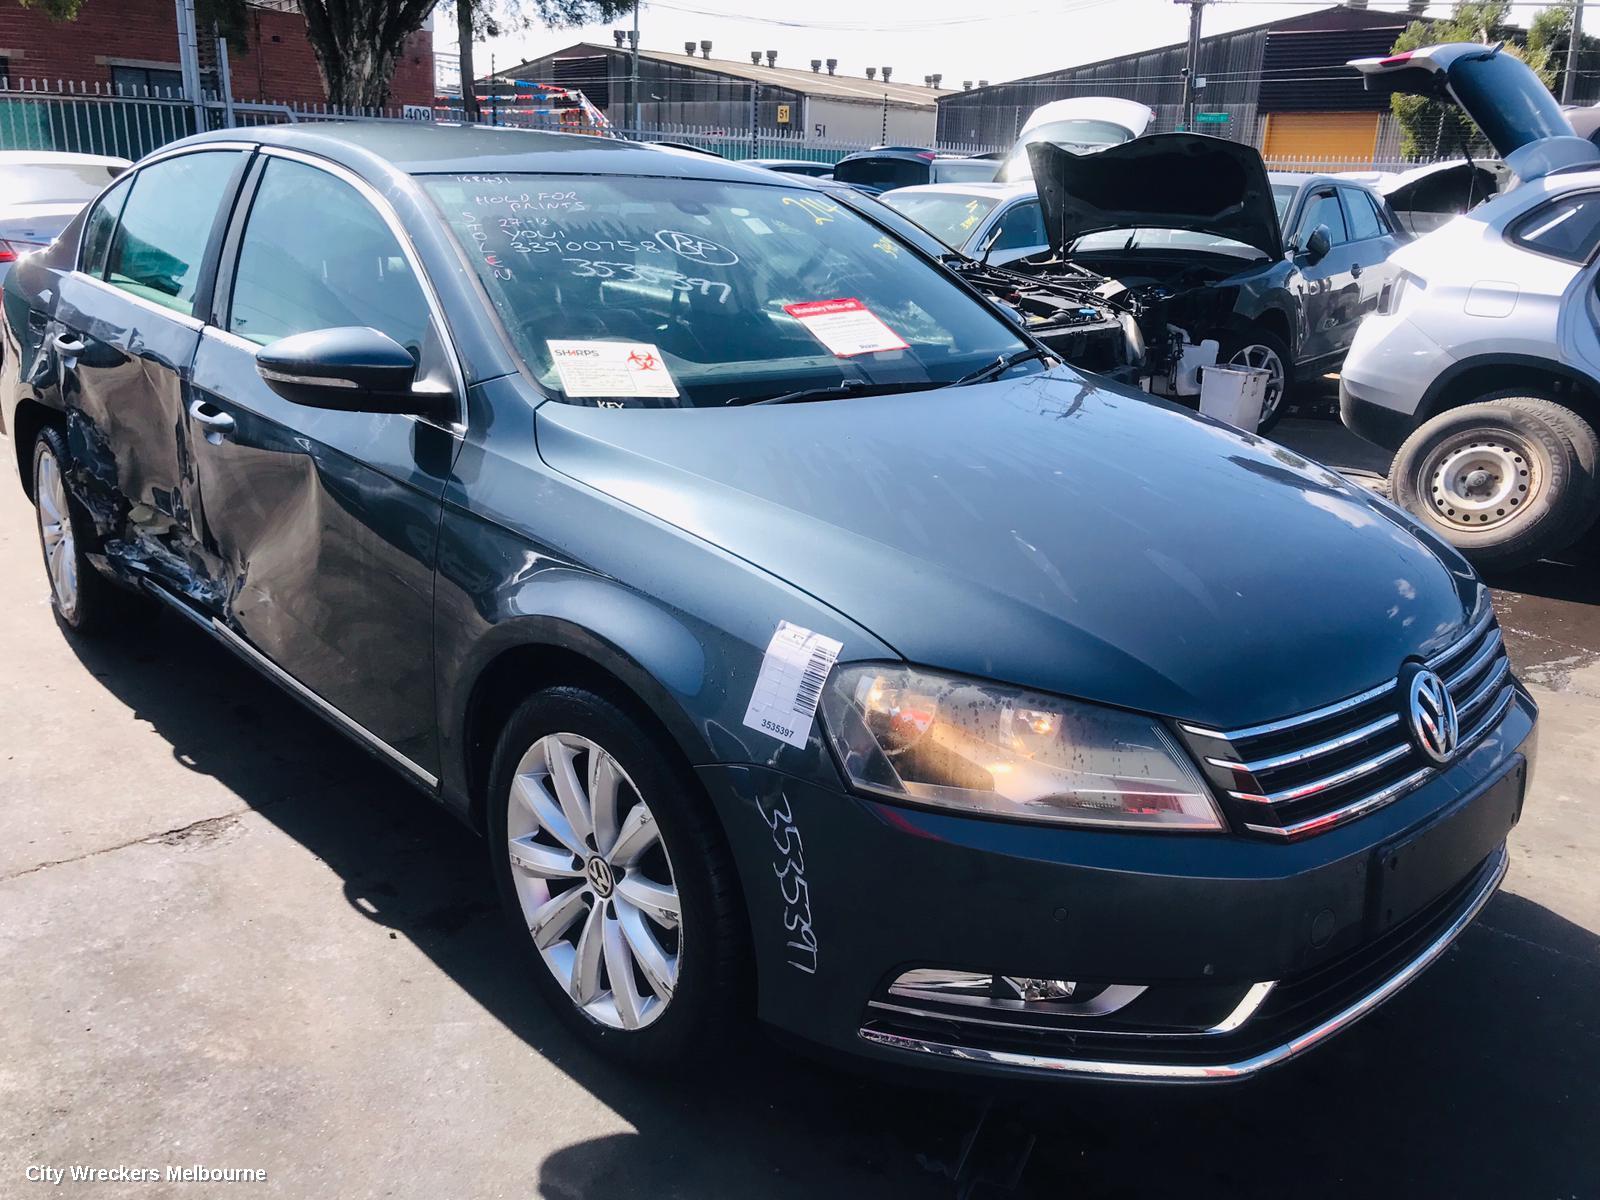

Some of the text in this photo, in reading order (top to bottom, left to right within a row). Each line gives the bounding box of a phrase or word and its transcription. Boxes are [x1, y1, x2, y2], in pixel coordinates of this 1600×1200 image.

[779, 108, 788, 119] 51
[815, 123, 826, 137] 51
[475, 191, 578, 205] HOLD FOR
[510, 201, 586, 213] PRINTS
[510, 240, 661, 254] 33900758
[761, 718, 795, 738] 3535397
[756, 792, 818, 974] 3535397
